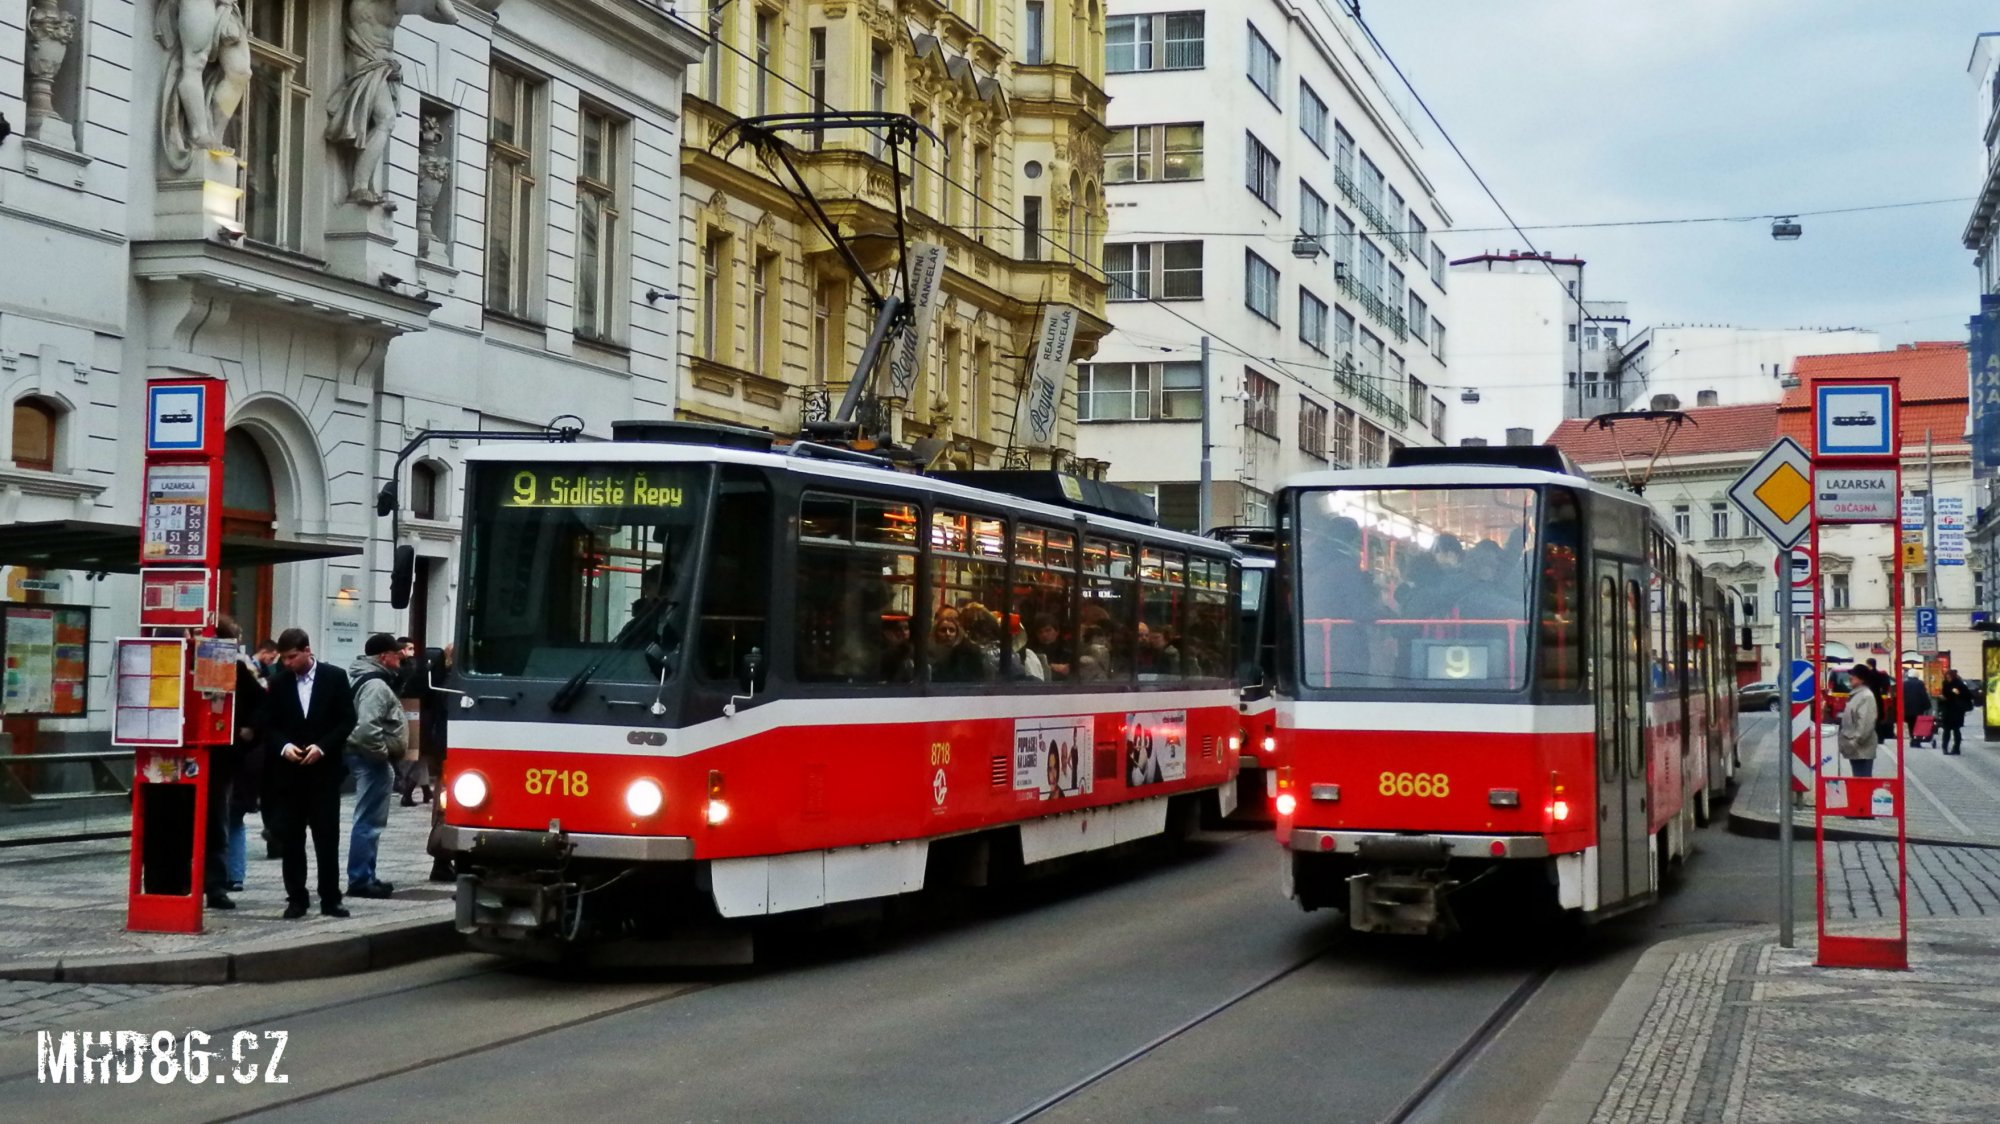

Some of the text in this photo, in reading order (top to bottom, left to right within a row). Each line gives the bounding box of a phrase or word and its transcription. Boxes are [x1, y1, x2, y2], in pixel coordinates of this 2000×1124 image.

[513, 471, 682, 507] 9 Sídliště Řepy
[1826, 478, 1886, 489] LAZARSKÁ
[155, 506, 201, 516] 3 24 54
[1834, 502, 1878, 512] OBČASNÁ
[154, 519, 160, 529] 9
[189, 519, 200, 529] 55
[152, 531, 200, 542] 14 51 56
[169, 544, 180, 554] 52
[187, 544, 199, 555] 58
[1446, 646, 1470, 678] 9
[931, 742, 950, 766] 8718
[525, 768, 589, 797] 8718
[1379, 771, 1450, 798] 8668
